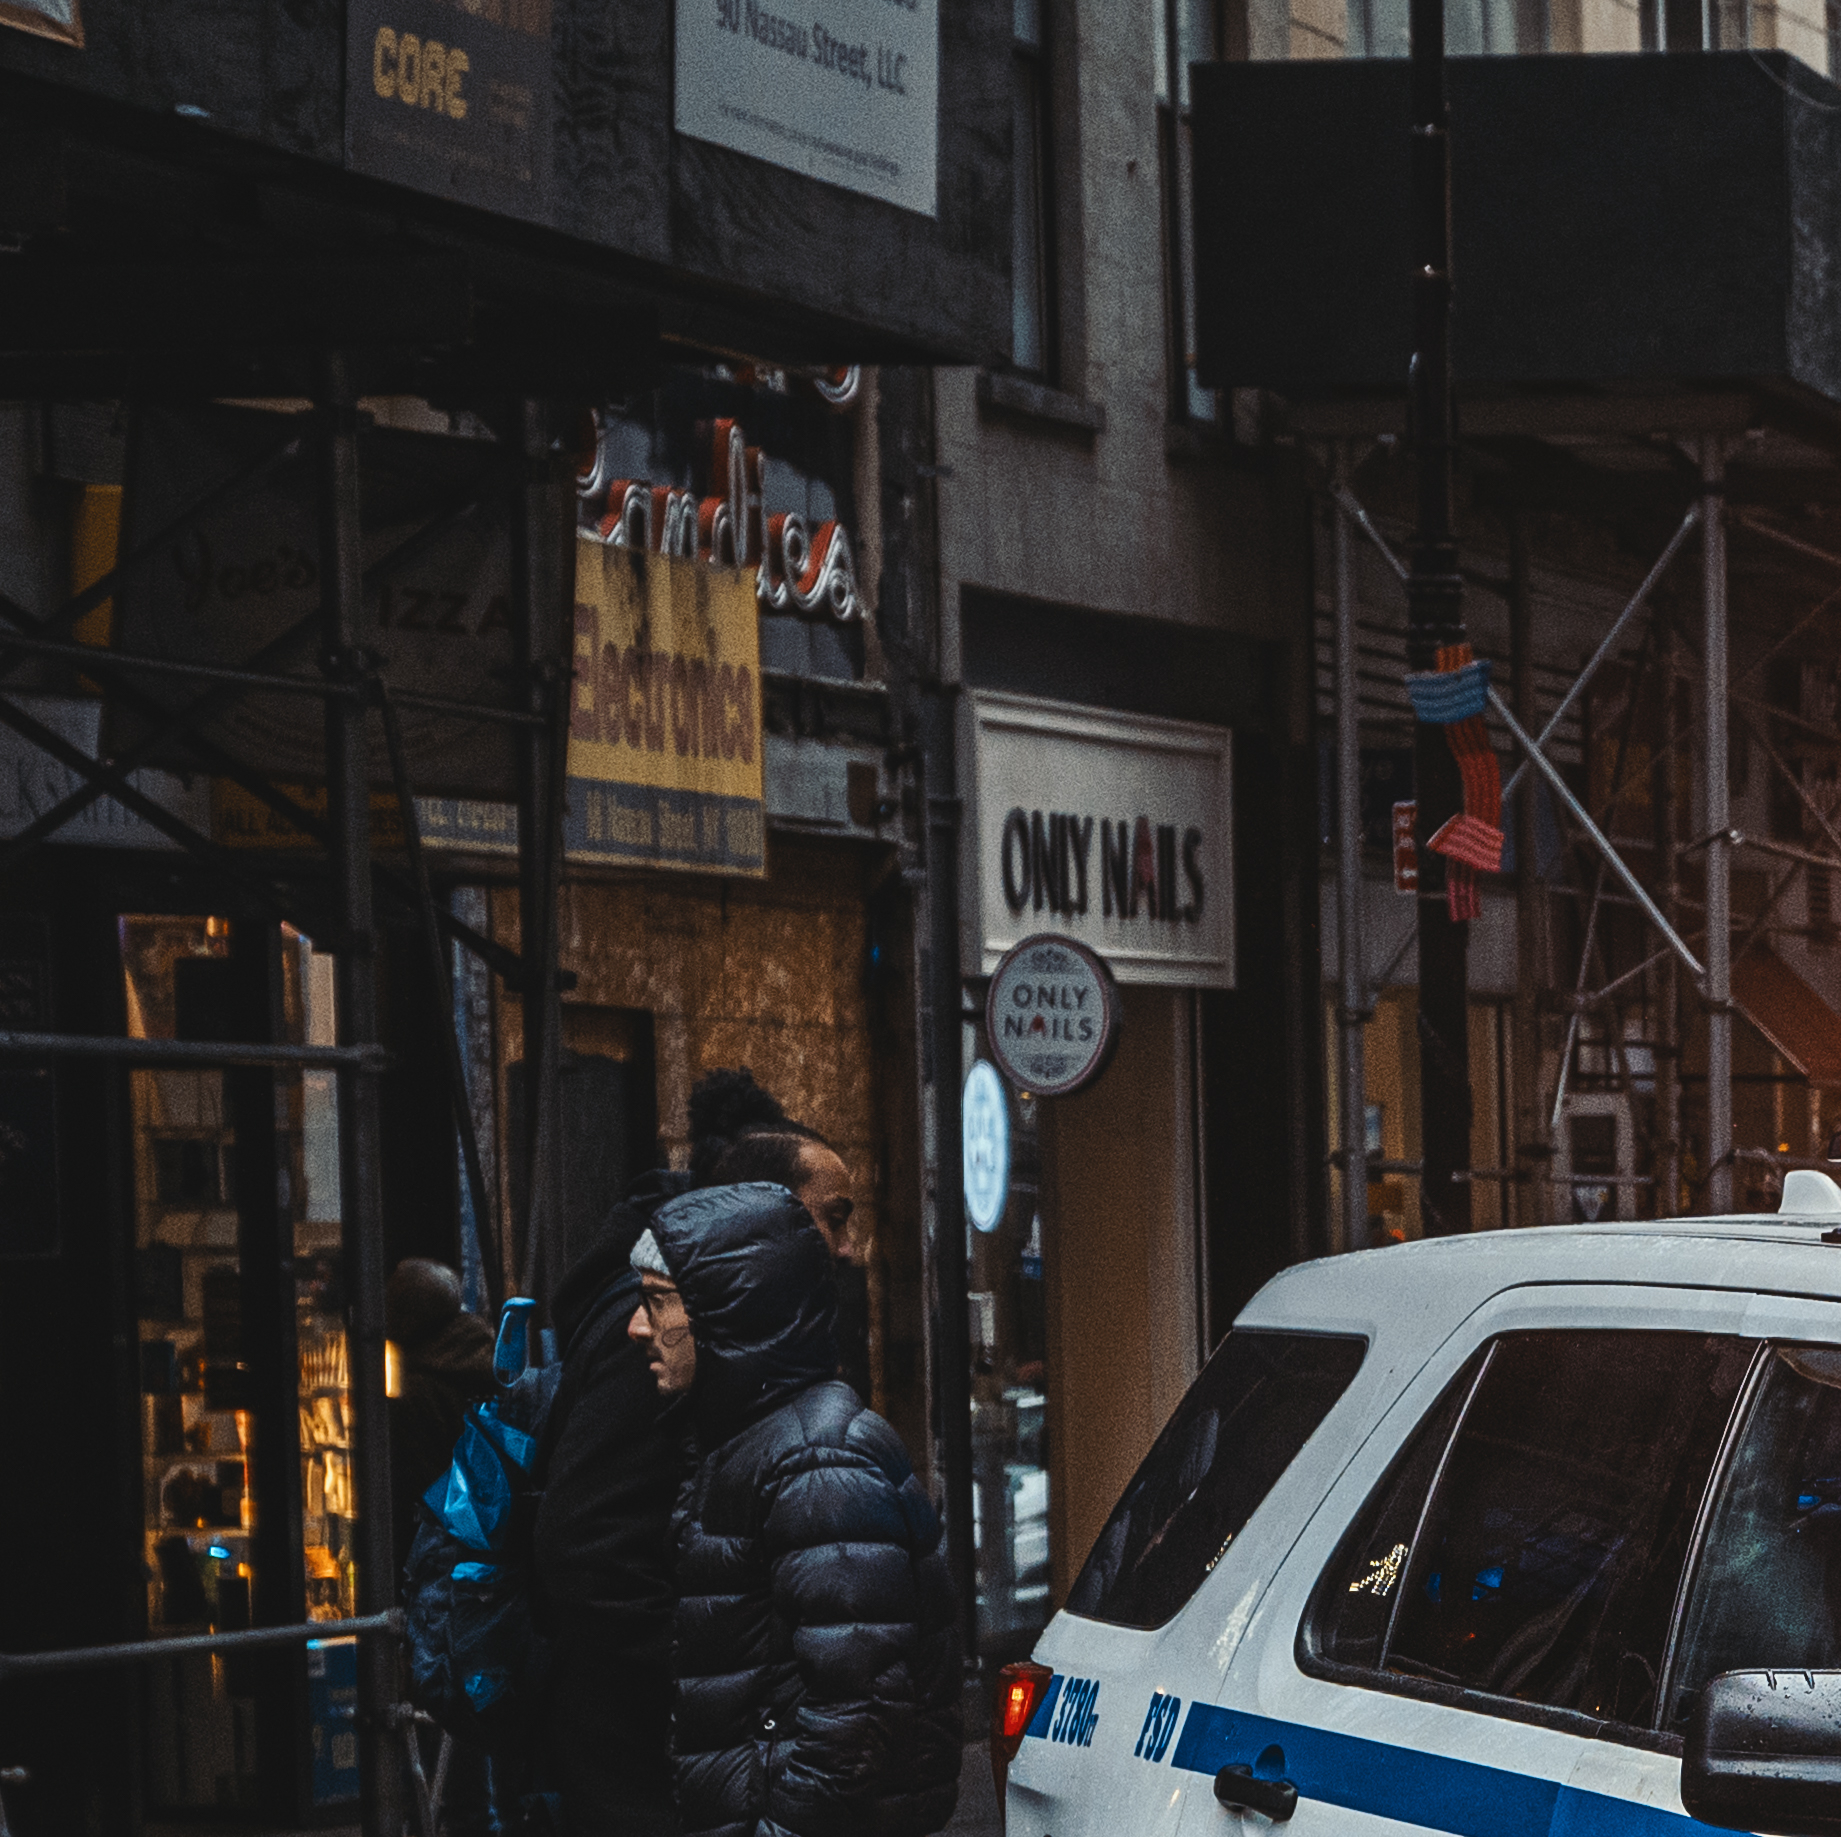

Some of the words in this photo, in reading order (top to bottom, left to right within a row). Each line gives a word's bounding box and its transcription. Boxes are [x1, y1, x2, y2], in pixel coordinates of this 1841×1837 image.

[372, 26, 470, 119] CORE
[877, 41, 908, 96] LLC
[1002, 806, 1094, 918] ONLY
[1101, 815, 1204, 924] NAILS
[1012, 984, 1090, 1011] ONLY
[1004, 1014, 1094, 1042] NAILS
